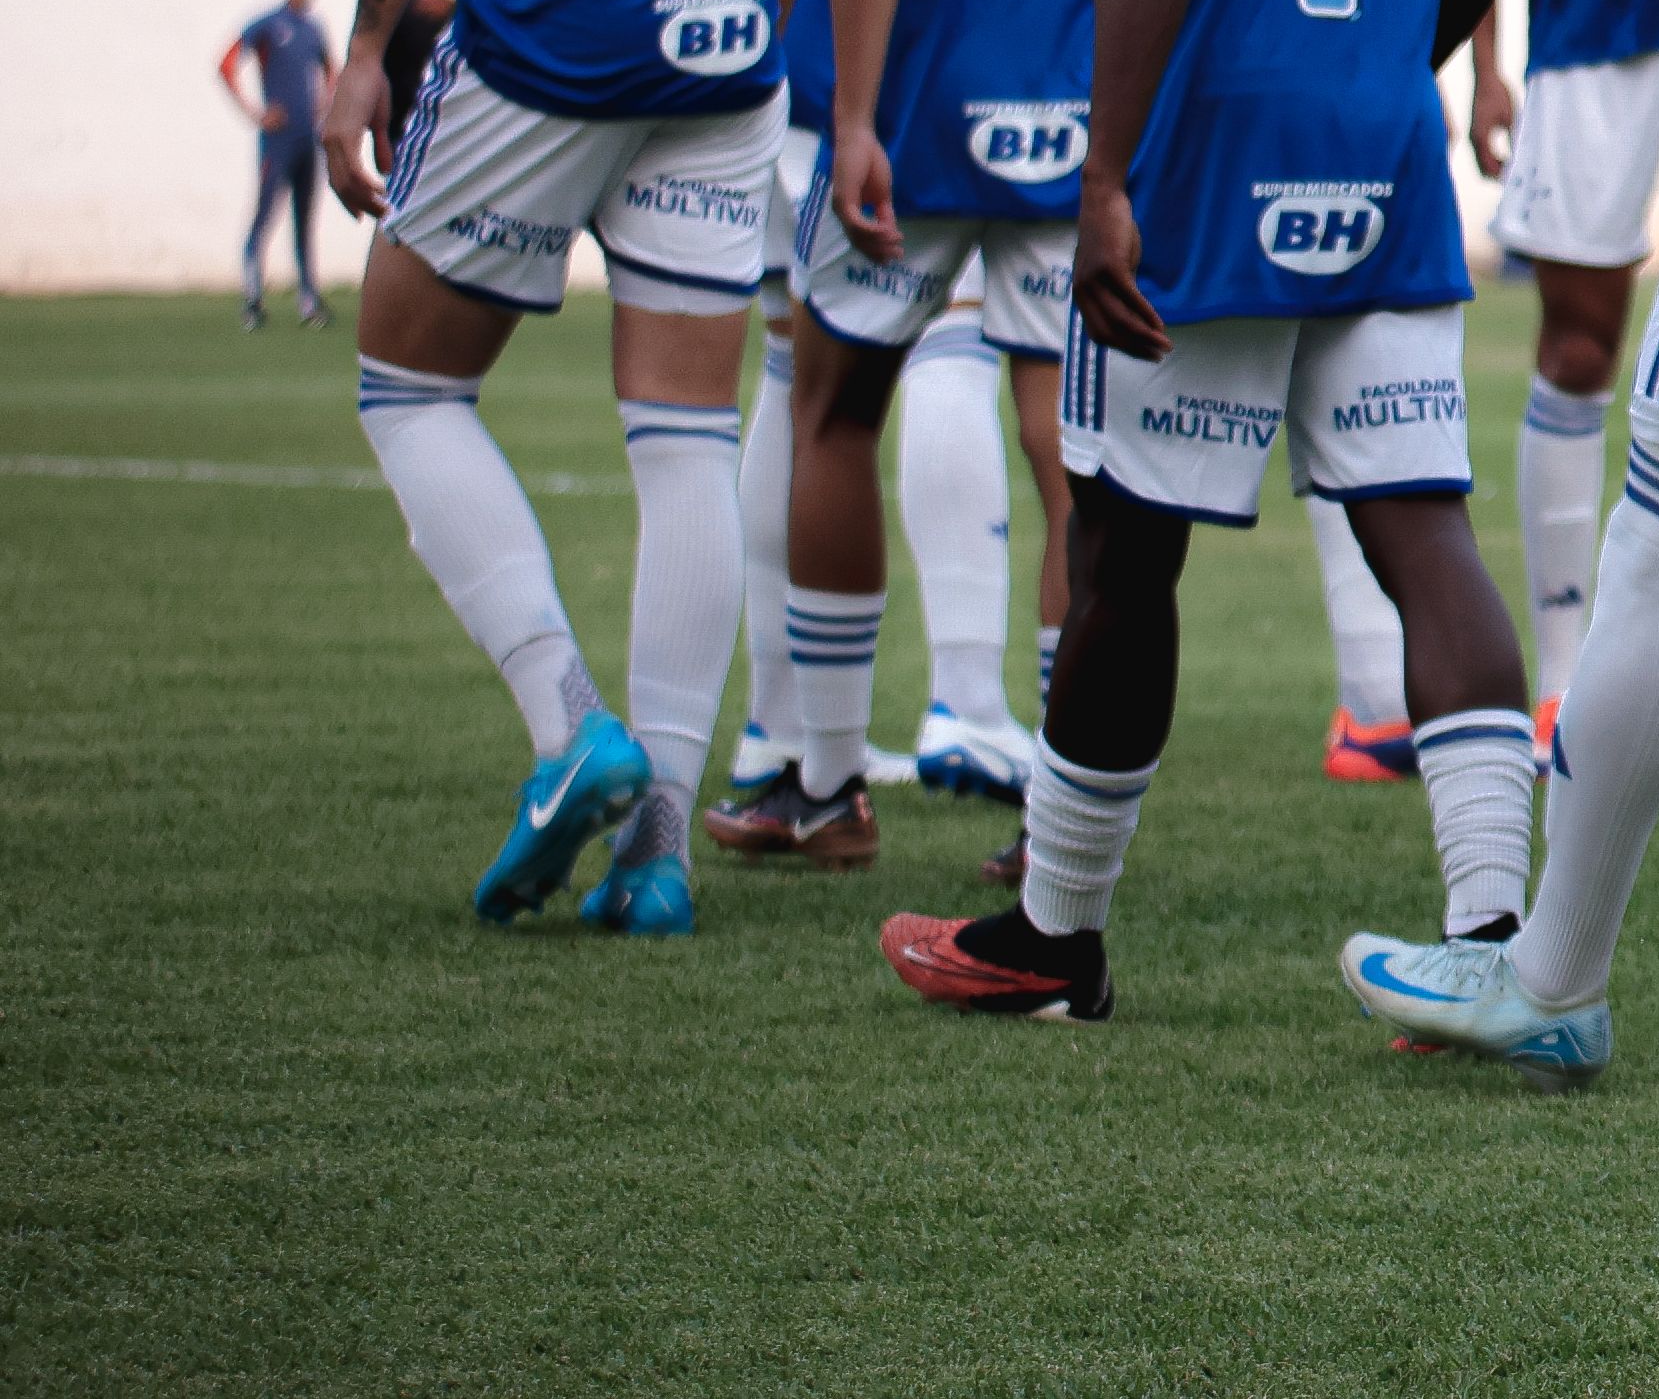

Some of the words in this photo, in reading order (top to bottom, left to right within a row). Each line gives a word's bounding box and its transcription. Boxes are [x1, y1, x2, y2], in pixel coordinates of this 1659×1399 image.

[678, 14, 758, 59] BH
[987, 126, 1074, 162] BH
[1272, 208, 1370, 253] BH
